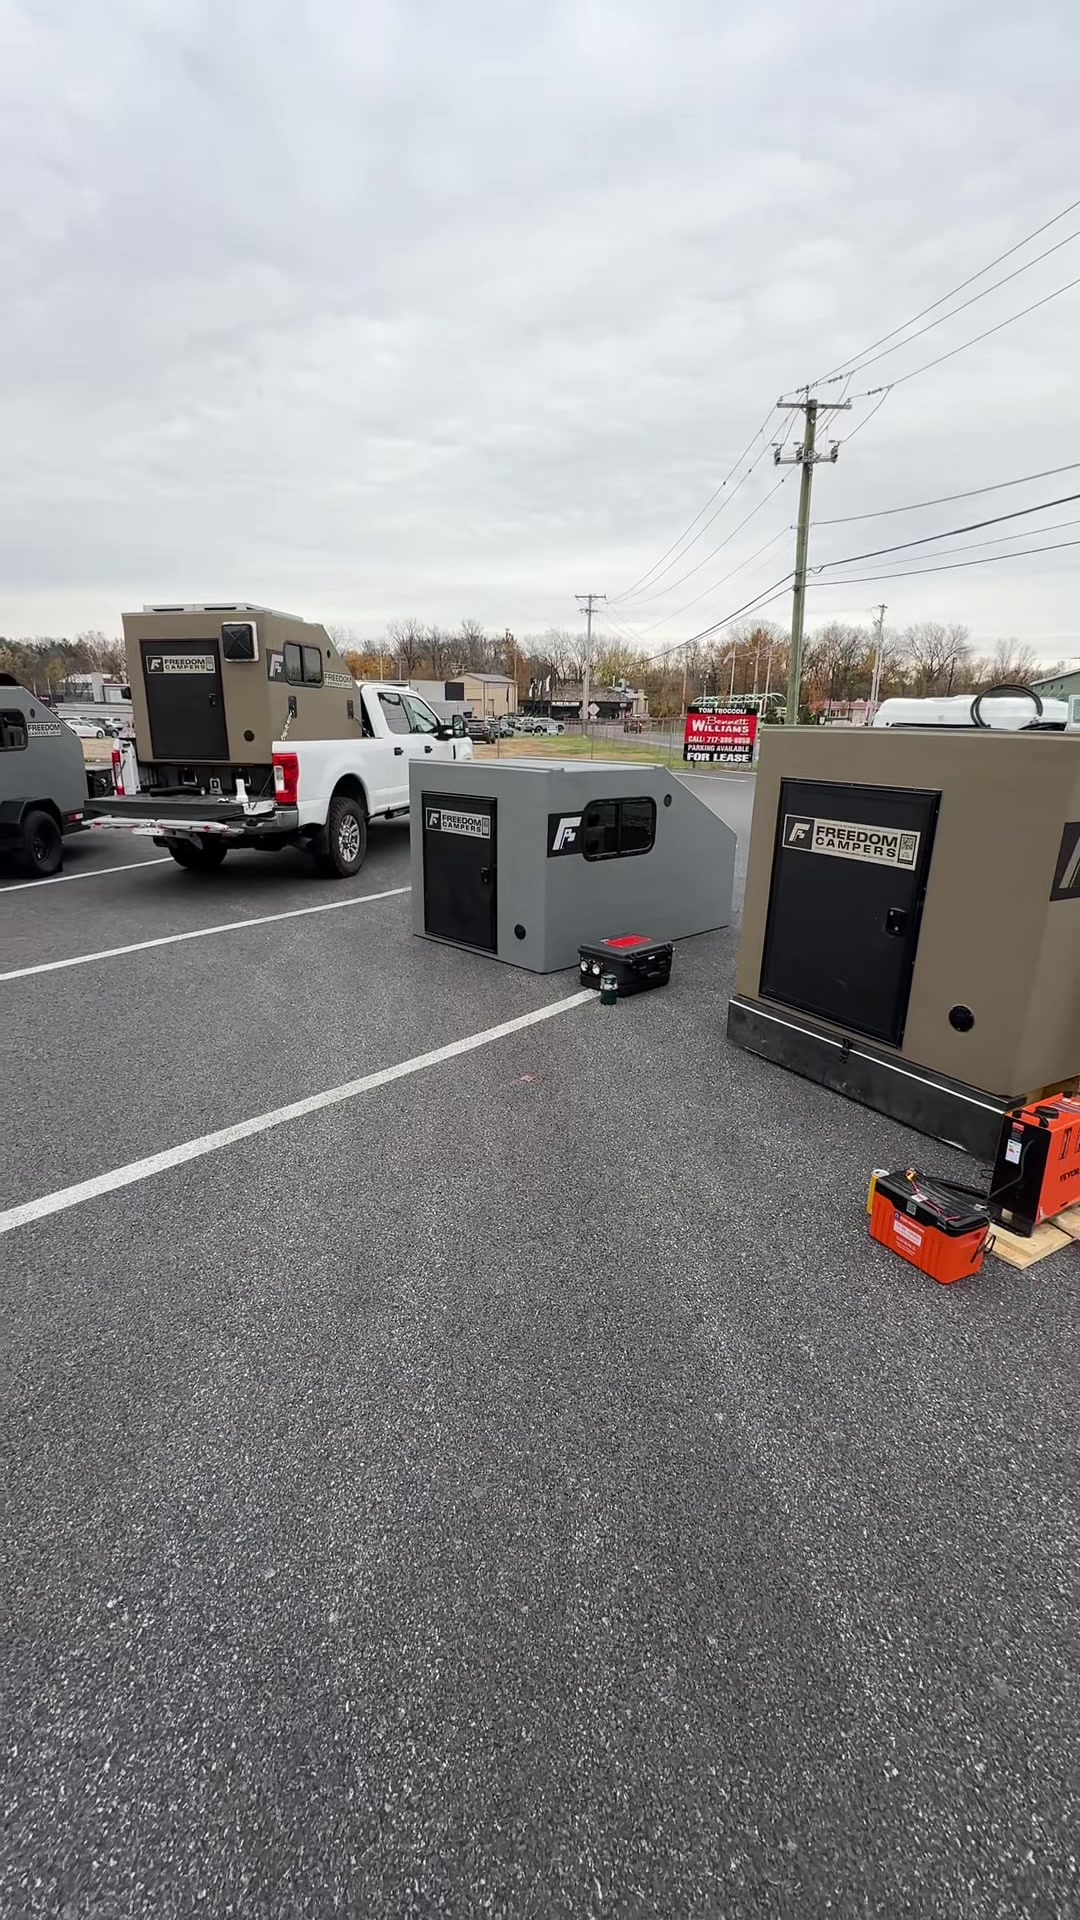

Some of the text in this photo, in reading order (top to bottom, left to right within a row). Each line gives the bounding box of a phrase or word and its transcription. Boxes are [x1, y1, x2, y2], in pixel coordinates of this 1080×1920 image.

[692, 720, 749, 732] WILLIAMS
[705, 716, 749, 725] Bennett
[687, 753, 749, 762] FOR LEASE
[442, 814, 482, 827] FREEDOM
[442, 822, 482, 833] CAMPERS
[816, 825, 898, 848] FREEDOM
[815, 836, 897, 858] CAMPERS
